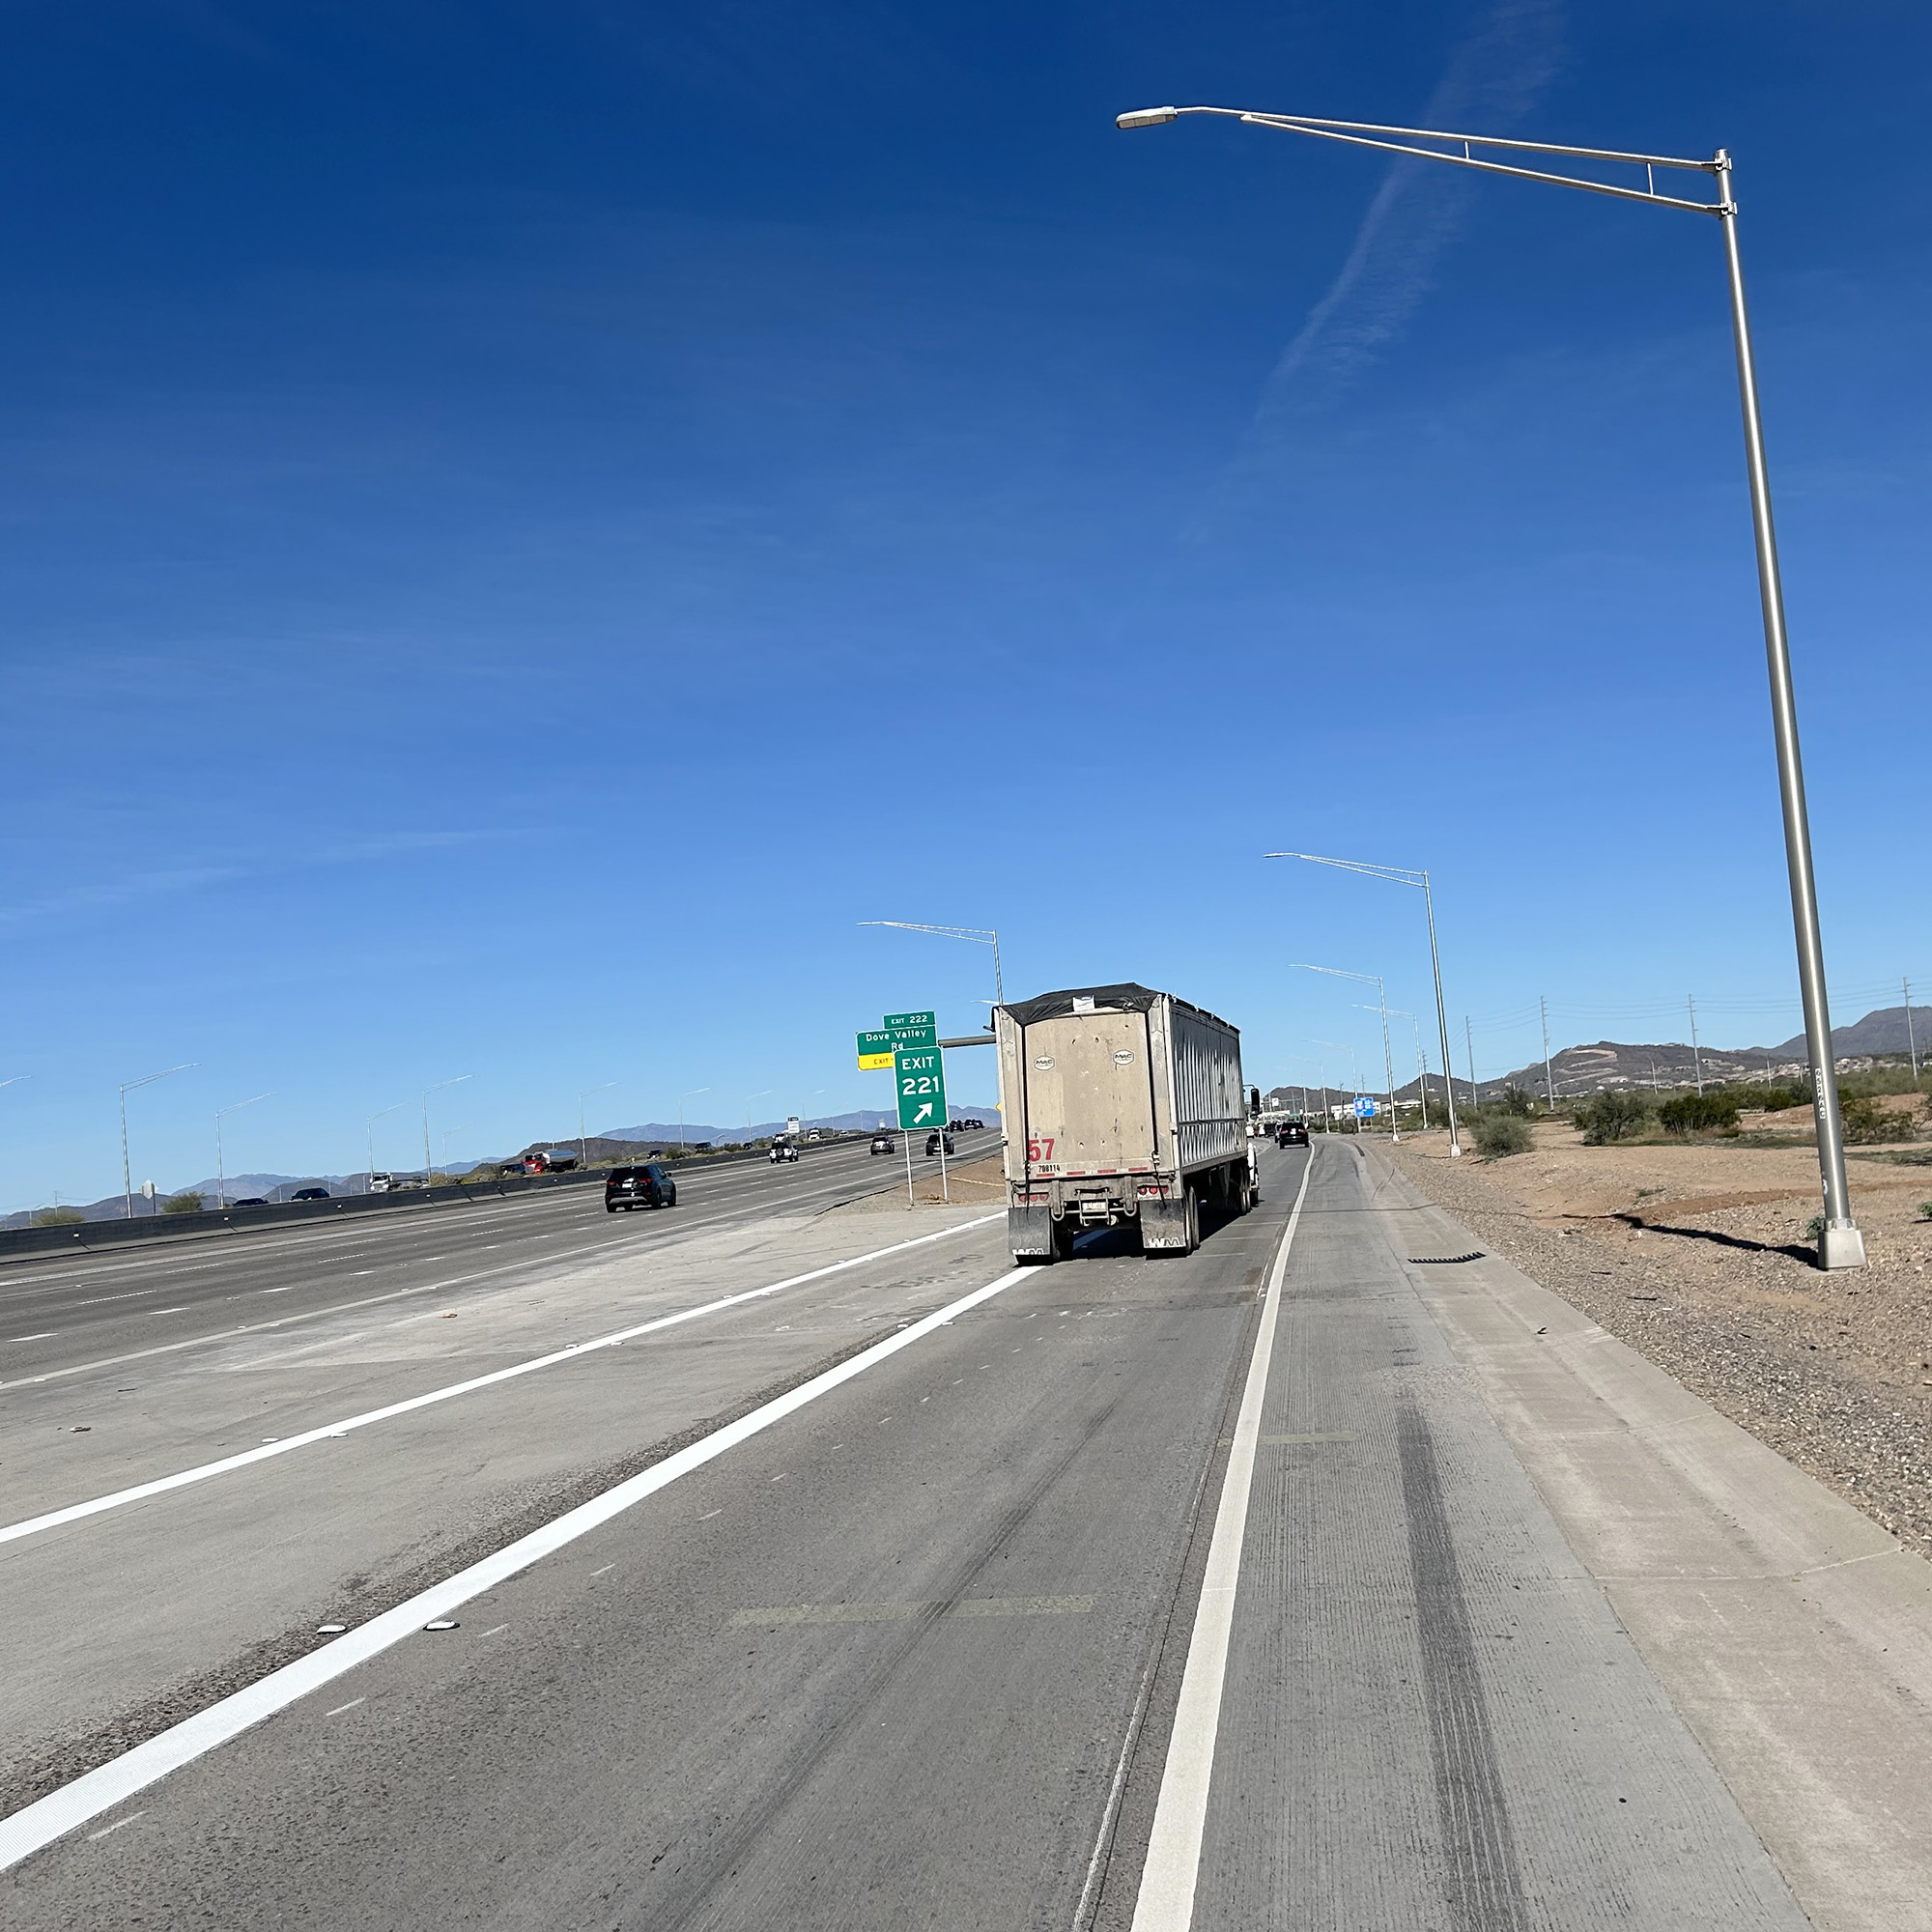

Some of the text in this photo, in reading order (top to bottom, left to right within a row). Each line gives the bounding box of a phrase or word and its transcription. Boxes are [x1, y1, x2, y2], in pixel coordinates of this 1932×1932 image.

[909, 1015, 928, 1024] 222
[895, 1030, 926, 1038] Valley
[891, 1042, 904, 1052] Rd
[901, 1056, 934, 1070] EXIT
[901, 1075, 939, 1095] 221
[1028, 1138, 1055, 1161] 57
